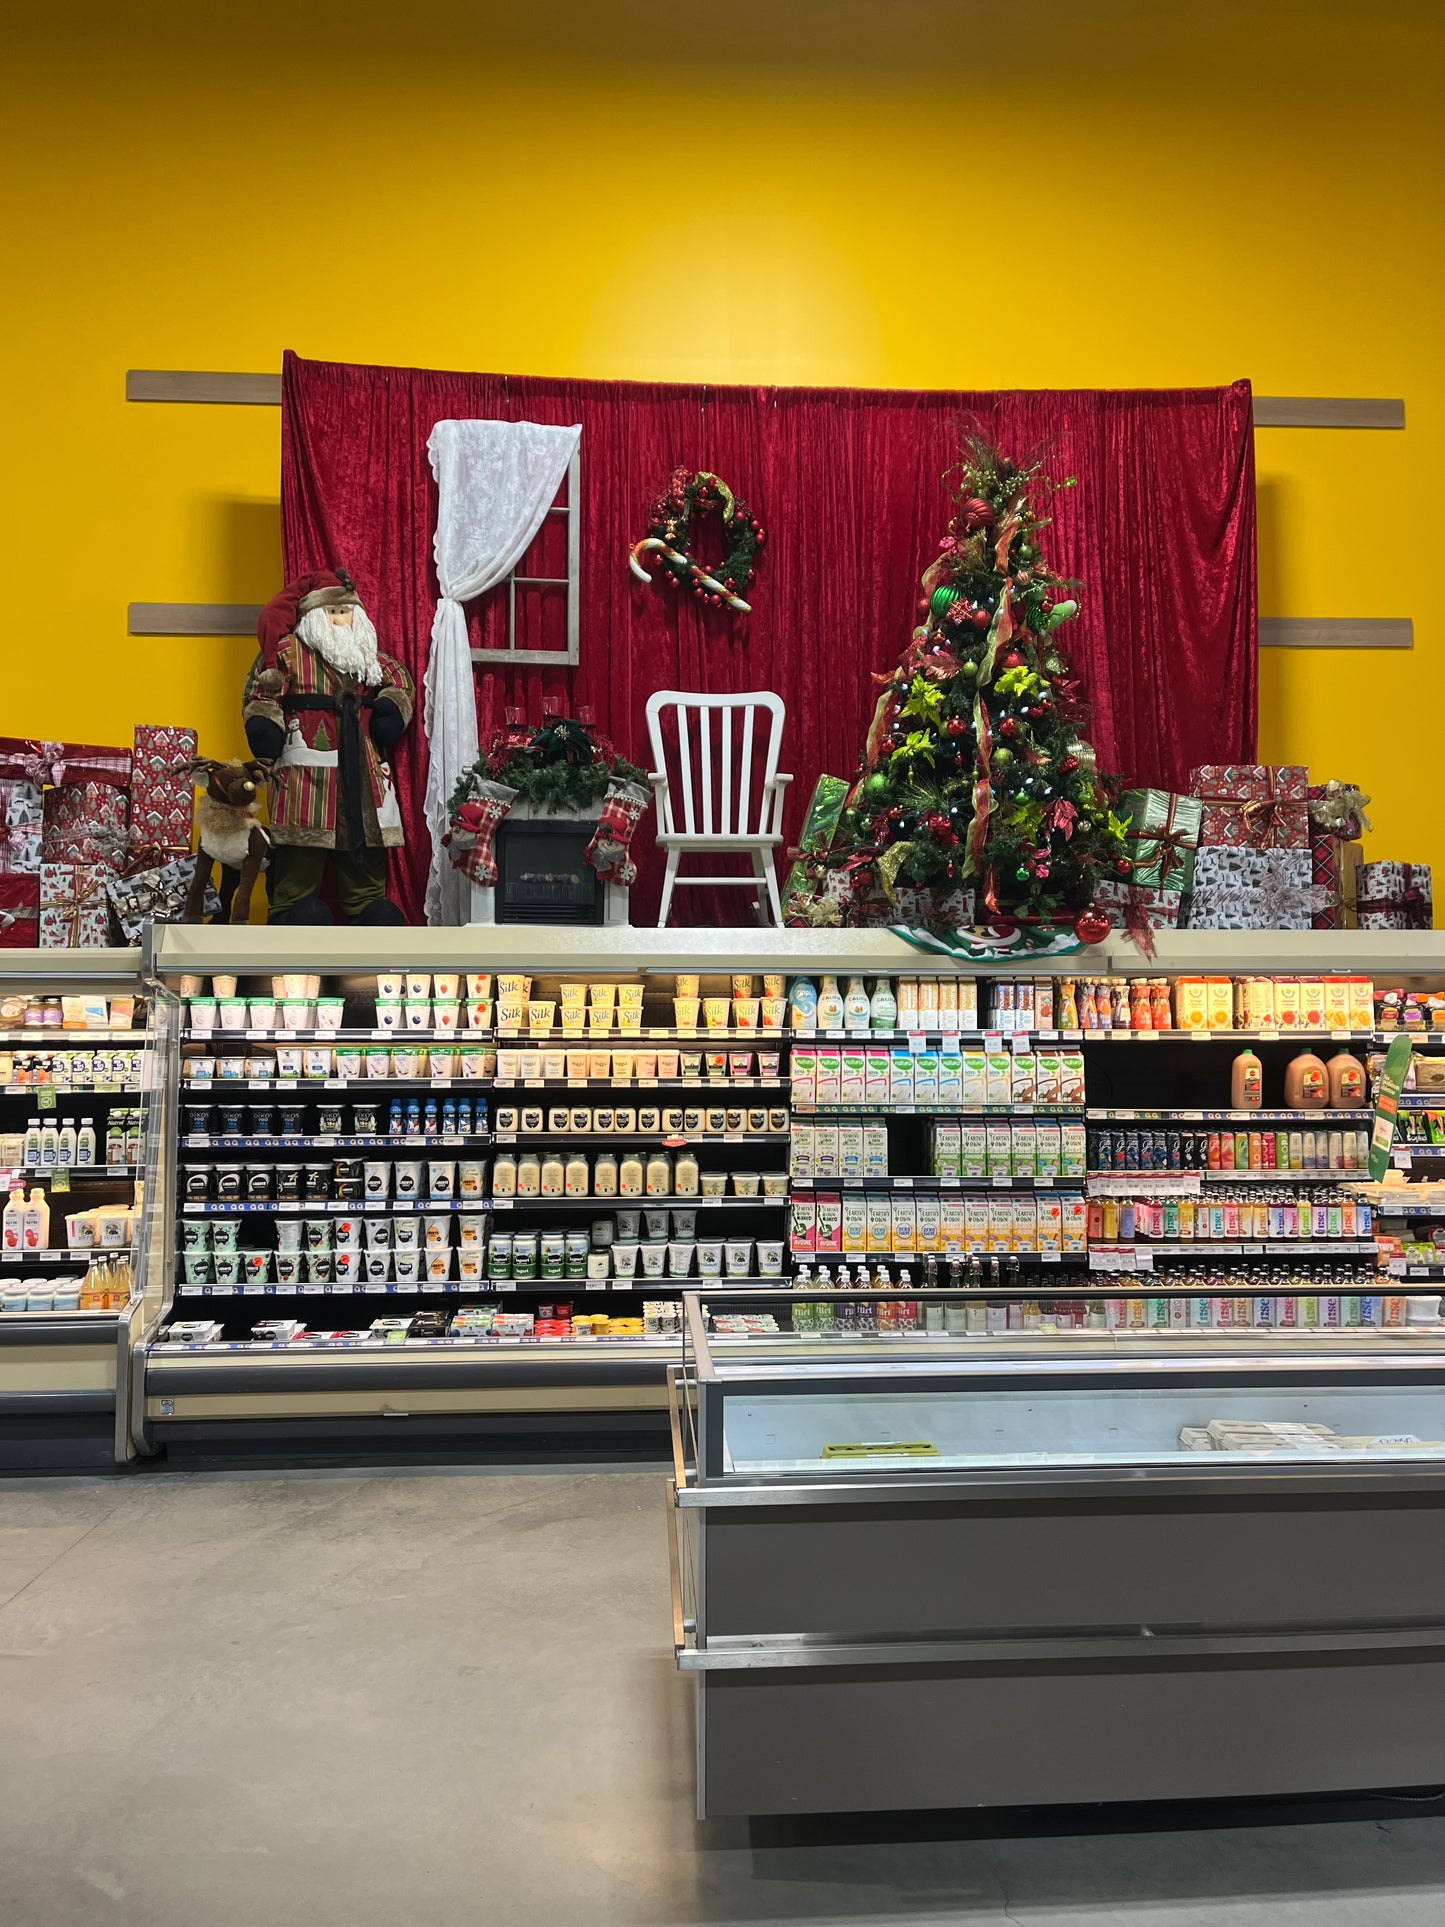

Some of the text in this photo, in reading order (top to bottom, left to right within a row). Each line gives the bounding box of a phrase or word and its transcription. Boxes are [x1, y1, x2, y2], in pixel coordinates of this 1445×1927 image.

[499, 981, 518, 995] Silk
[734, 978, 750, 990] Silk
[563, 988, 578, 999] Silk
[592, 988, 607, 998] Silk
[626, 988, 641, 999] Silk
[501, 1008, 520, 1021] Silk
[531, 1007, 550, 1021] Silk
[565, 1010, 580, 1020] Silk
[594, 1010, 609, 1021] Silk
[624, 1010, 640, 1020] Silk
[707, 1005, 723, 1016] Silk
[739, 1005, 756, 1016] Silk
[764, 1005, 780, 1016] Silk
[857, 1306, 872, 1314] flirt
